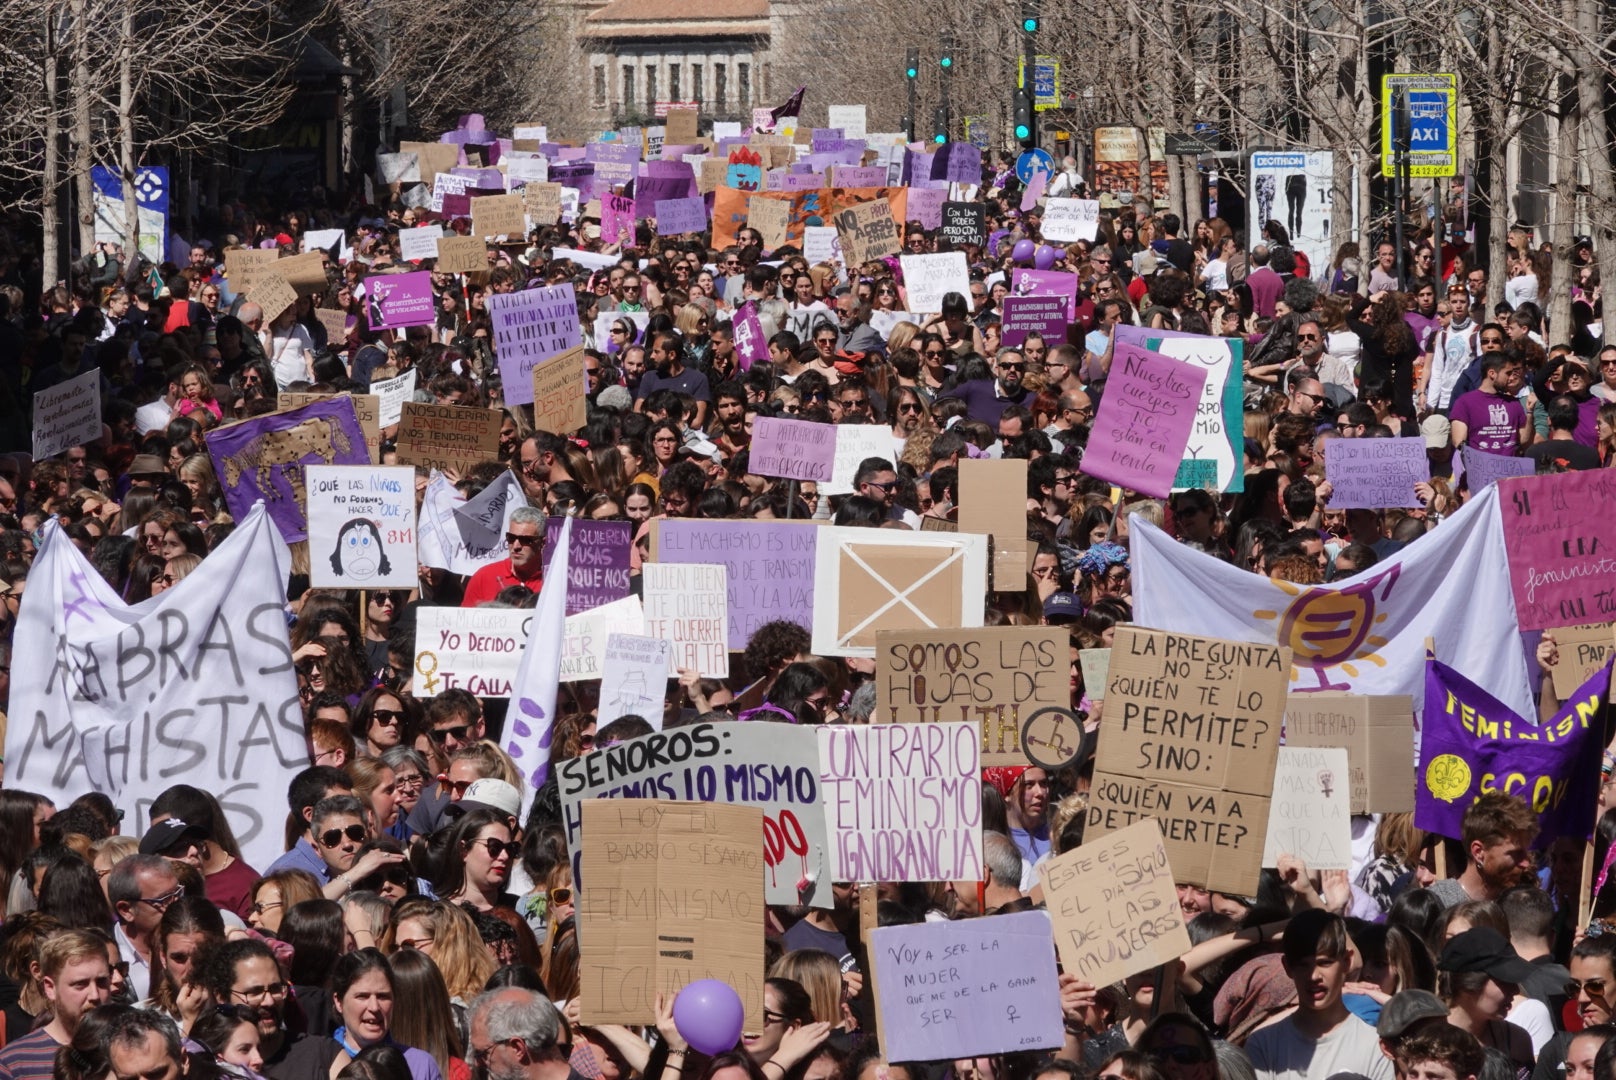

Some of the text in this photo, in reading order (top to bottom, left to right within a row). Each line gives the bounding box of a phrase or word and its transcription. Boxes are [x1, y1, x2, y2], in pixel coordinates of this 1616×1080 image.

[834, 209, 857, 237] NO
[947, 208, 961, 217] CON
[943, 226, 977, 235] PERO CON
[280, 394, 291, 408] SI
[406, 405, 436, 417] NOS
[402, 429, 424, 439] NOS
[312, 477, 339, 497] ¿QUÉ
[348, 479, 365, 490] LAS
[333, 495, 384, 505] NO PODEMOS
[348, 506, 373, 515] HACER
[387, 529, 412, 545] 8M
[578, 527, 630, 545] QUIEREN
[665, 532, 684, 550] EL
[767, 532, 783, 551] ES
[790, 532, 817, 550] UNA
[604, 568, 630, 590] NOS
[646, 565, 687, 591] QUIEN
[693, 565, 725, 592] BIEN
[743, 559, 757, 581] DE
[648, 593, 668, 617] TE
[763, 587, 780, 609] LA
[440, 629, 516, 653] YO DECIDO
[1131, 631, 1282, 672] LA PREGUNTA
[889, 638, 1057, 674] SOMOS LAS
[1164, 659, 1233, 681] NO ES:
[888, 670, 1057, 705] HIJAS DE
[1197, 686, 1220, 706] TE
[1237, 690, 1263, 712] LO
[1308, 711, 1356, 737] LIBERTAD
[562, 723, 733, 795] SEÑOROS:
[683, 764, 717, 801] LO
[724, 763, 817, 804] MISMO
[1187, 795, 1216, 816] VA
[1227, 801, 1243, 819] A
[618, 805, 718, 834] HOY EN
[603, 841, 678, 865] BARRIO
[687, 838, 758, 870] SÉSAMO
[836, 828, 982, 883] IGNORANCIA
[1098, 839, 1131, 864] ES
[586, 887, 752, 923] FEMINISMO
[1061, 885, 1126, 918] EL DIA
[1070, 890, 1161, 950] DE LAS
[888, 938, 1000, 966] VOY A SER LA
[904, 967, 961, 988] MUJER
[906, 976, 1037, 1006] QUE ME DE LA GANA
[920, 1006, 957, 1029] SER
[1019, 1034, 1043, 1046] 2020
